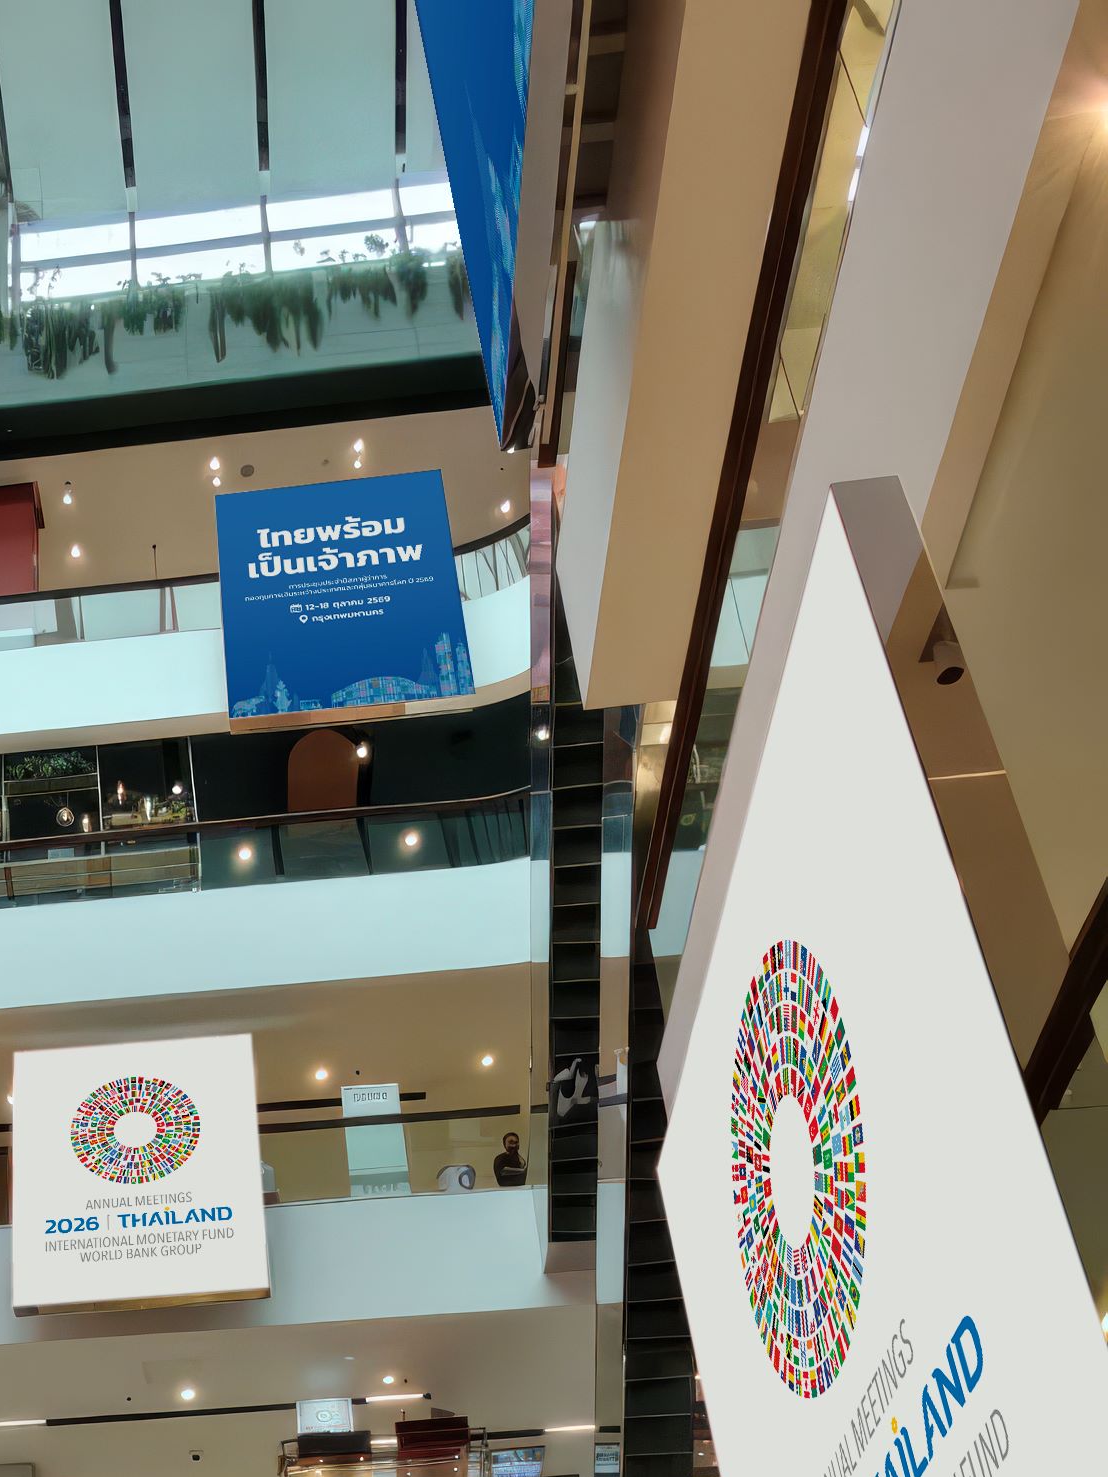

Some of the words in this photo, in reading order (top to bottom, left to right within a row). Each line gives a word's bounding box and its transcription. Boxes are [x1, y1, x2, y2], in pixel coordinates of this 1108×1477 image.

[256, 515, 405, 548] ไทยพร้อม
[248, 543, 422, 578] เป็นเจ้าภาพ
[305, 602, 329, 610] 12-18
[332, 599, 363, 608] ตุลาคม
[367, 595, 390, 604] 2569
[85, 1196, 132, 1210] ANNUAL
[135, 1191, 192, 1206] MEETINGS
[44, 1216, 99, 1234] 2026
[116, 1206, 232, 1228] THAILAND
[45, 1235, 134, 1252] INTERNATIONAL
[136, 1229, 199, 1245] MONETARY
[202, 1226, 234, 1240] FUND
[79, 1249, 122, 1262] WORLD
[126, 1246, 157, 1258] BANK
[160, 1243, 201, 1256] GROUP
[851, 1319, 913, 1458] MEETINGS
